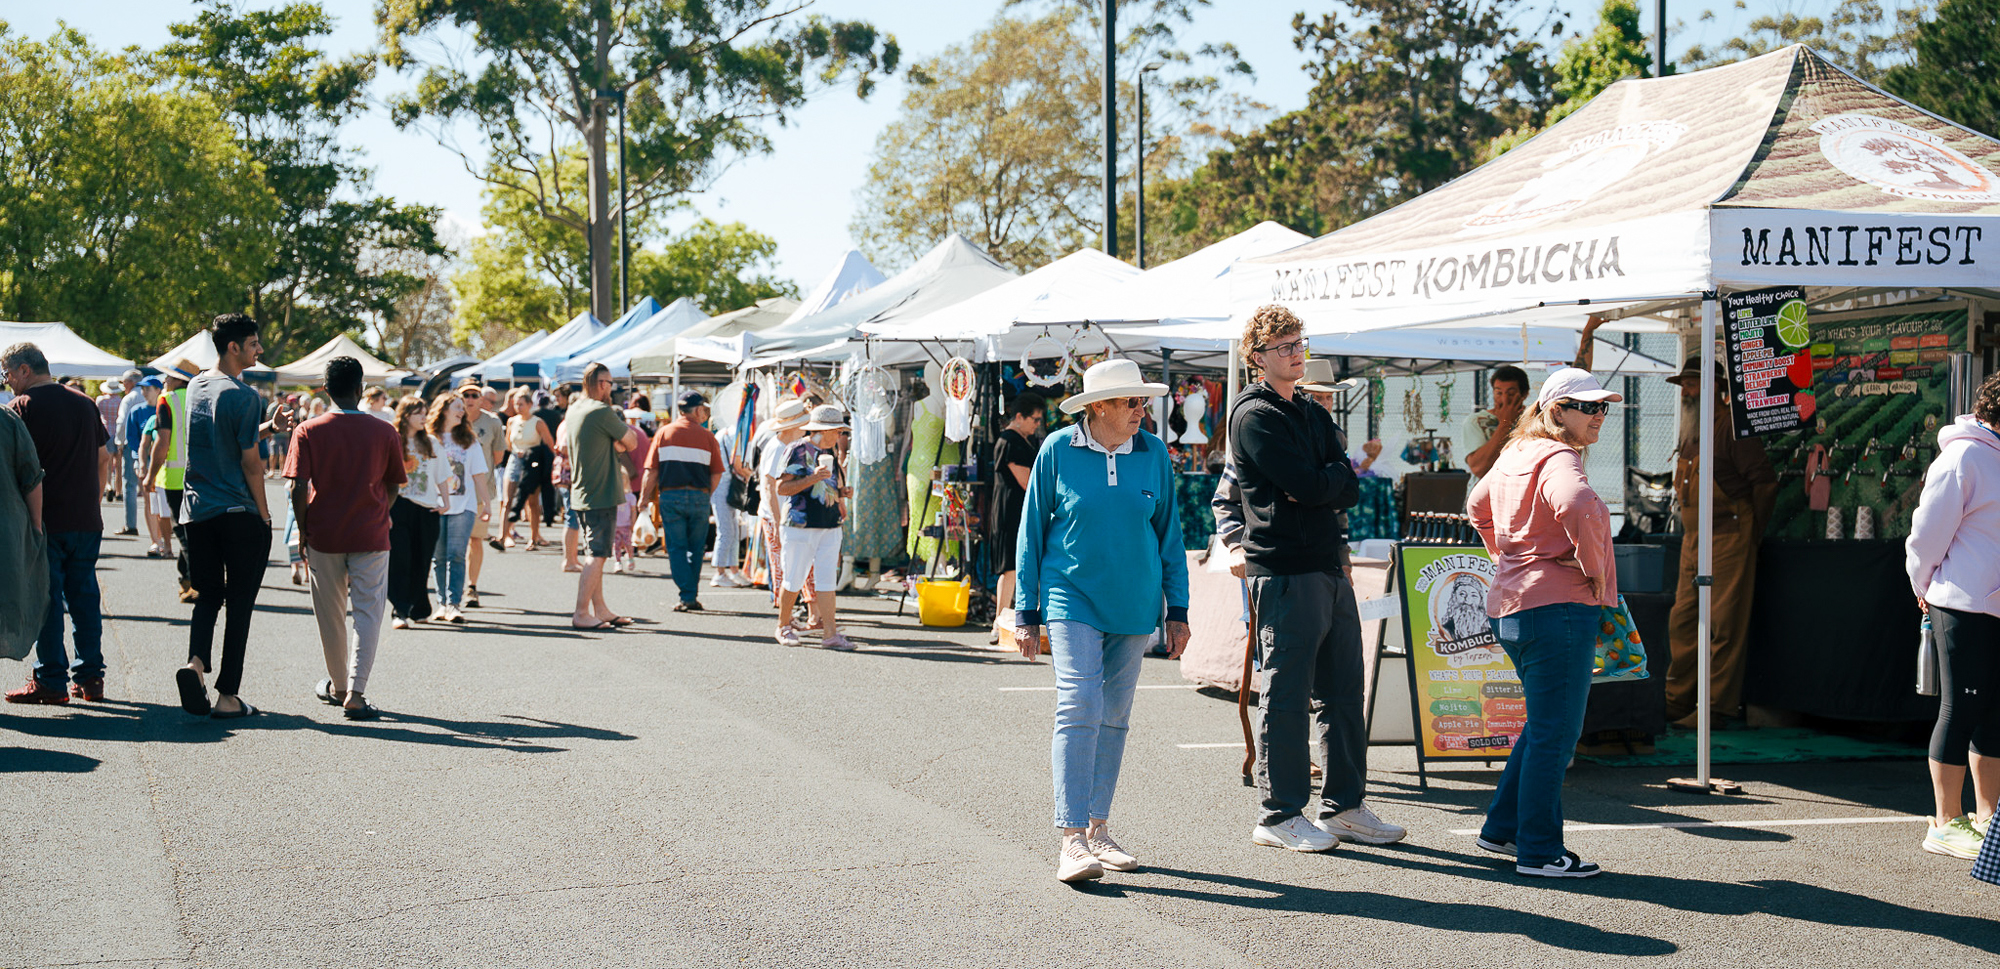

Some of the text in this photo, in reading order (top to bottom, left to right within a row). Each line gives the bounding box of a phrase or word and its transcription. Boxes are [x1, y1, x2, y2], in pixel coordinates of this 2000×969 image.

[1818, 116, 1938, 143] MANIFEST
[1741, 225, 1982, 267] MANIFEST
[1271, 235, 1625, 302] MANIFEST KOMBUCHA
[1727, 290, 1799, 308] Your Healthy Choice
[1737, 308, 1753, 319] LIME
[1738, 315, 1777, 329] BITTER LIME
[1739, 328, 1764, 340] MOJITO
[1860, 324, 1881, 337] YOUR
[1740, 339, 1764, 351] GINGER
[1742, 347, 1774, 361] APPLE PIE
[1742, 355, 1795, 372] IMMUNITY BOOST
[1744, 367, 1787, 382] STRAWBERRY
[1744, 379, 1771, 391] DELIGHT
[1745, 389, 1766, 401] CHILLI
[1746, 394, 1789, 409] STRAWBERRY
[1422, 555, 1499, 582] MANIFES
[1440, 634, 1498, 653] KOMBUC
[1485, 669, 1519, 680] FLAVOU
[1439, 704, 1467, 712] Mojito
[1496, 703, 1524, 711] Ginger
[1438, 720, 1479, 729] Apple Pie
[1469, 738, 1491, 747] SOLD
[1492, 736, 1507, 745] OUT
